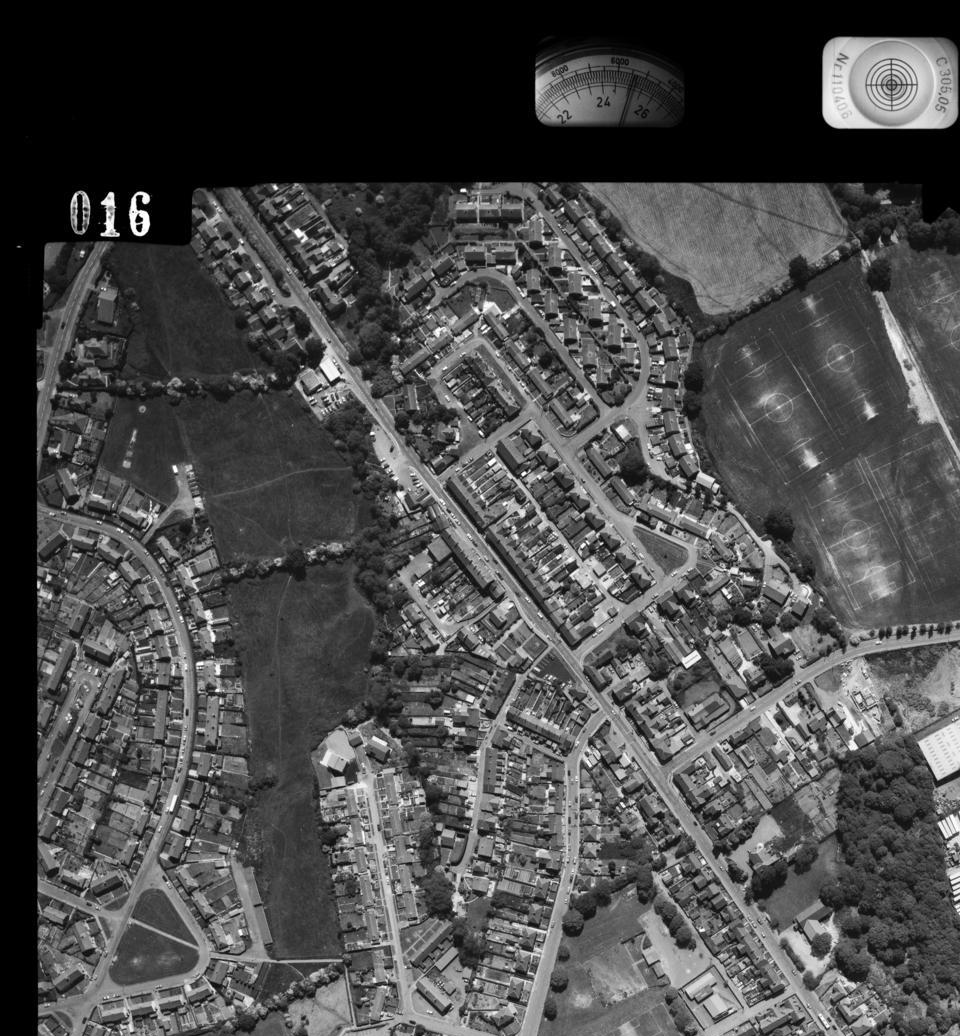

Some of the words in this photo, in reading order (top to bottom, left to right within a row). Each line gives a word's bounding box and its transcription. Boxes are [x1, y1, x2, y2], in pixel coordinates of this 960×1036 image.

[556, 110, 573, 125] 22
[596, 96, 611, 108] 24
[633, 104, 650, 119] 26
